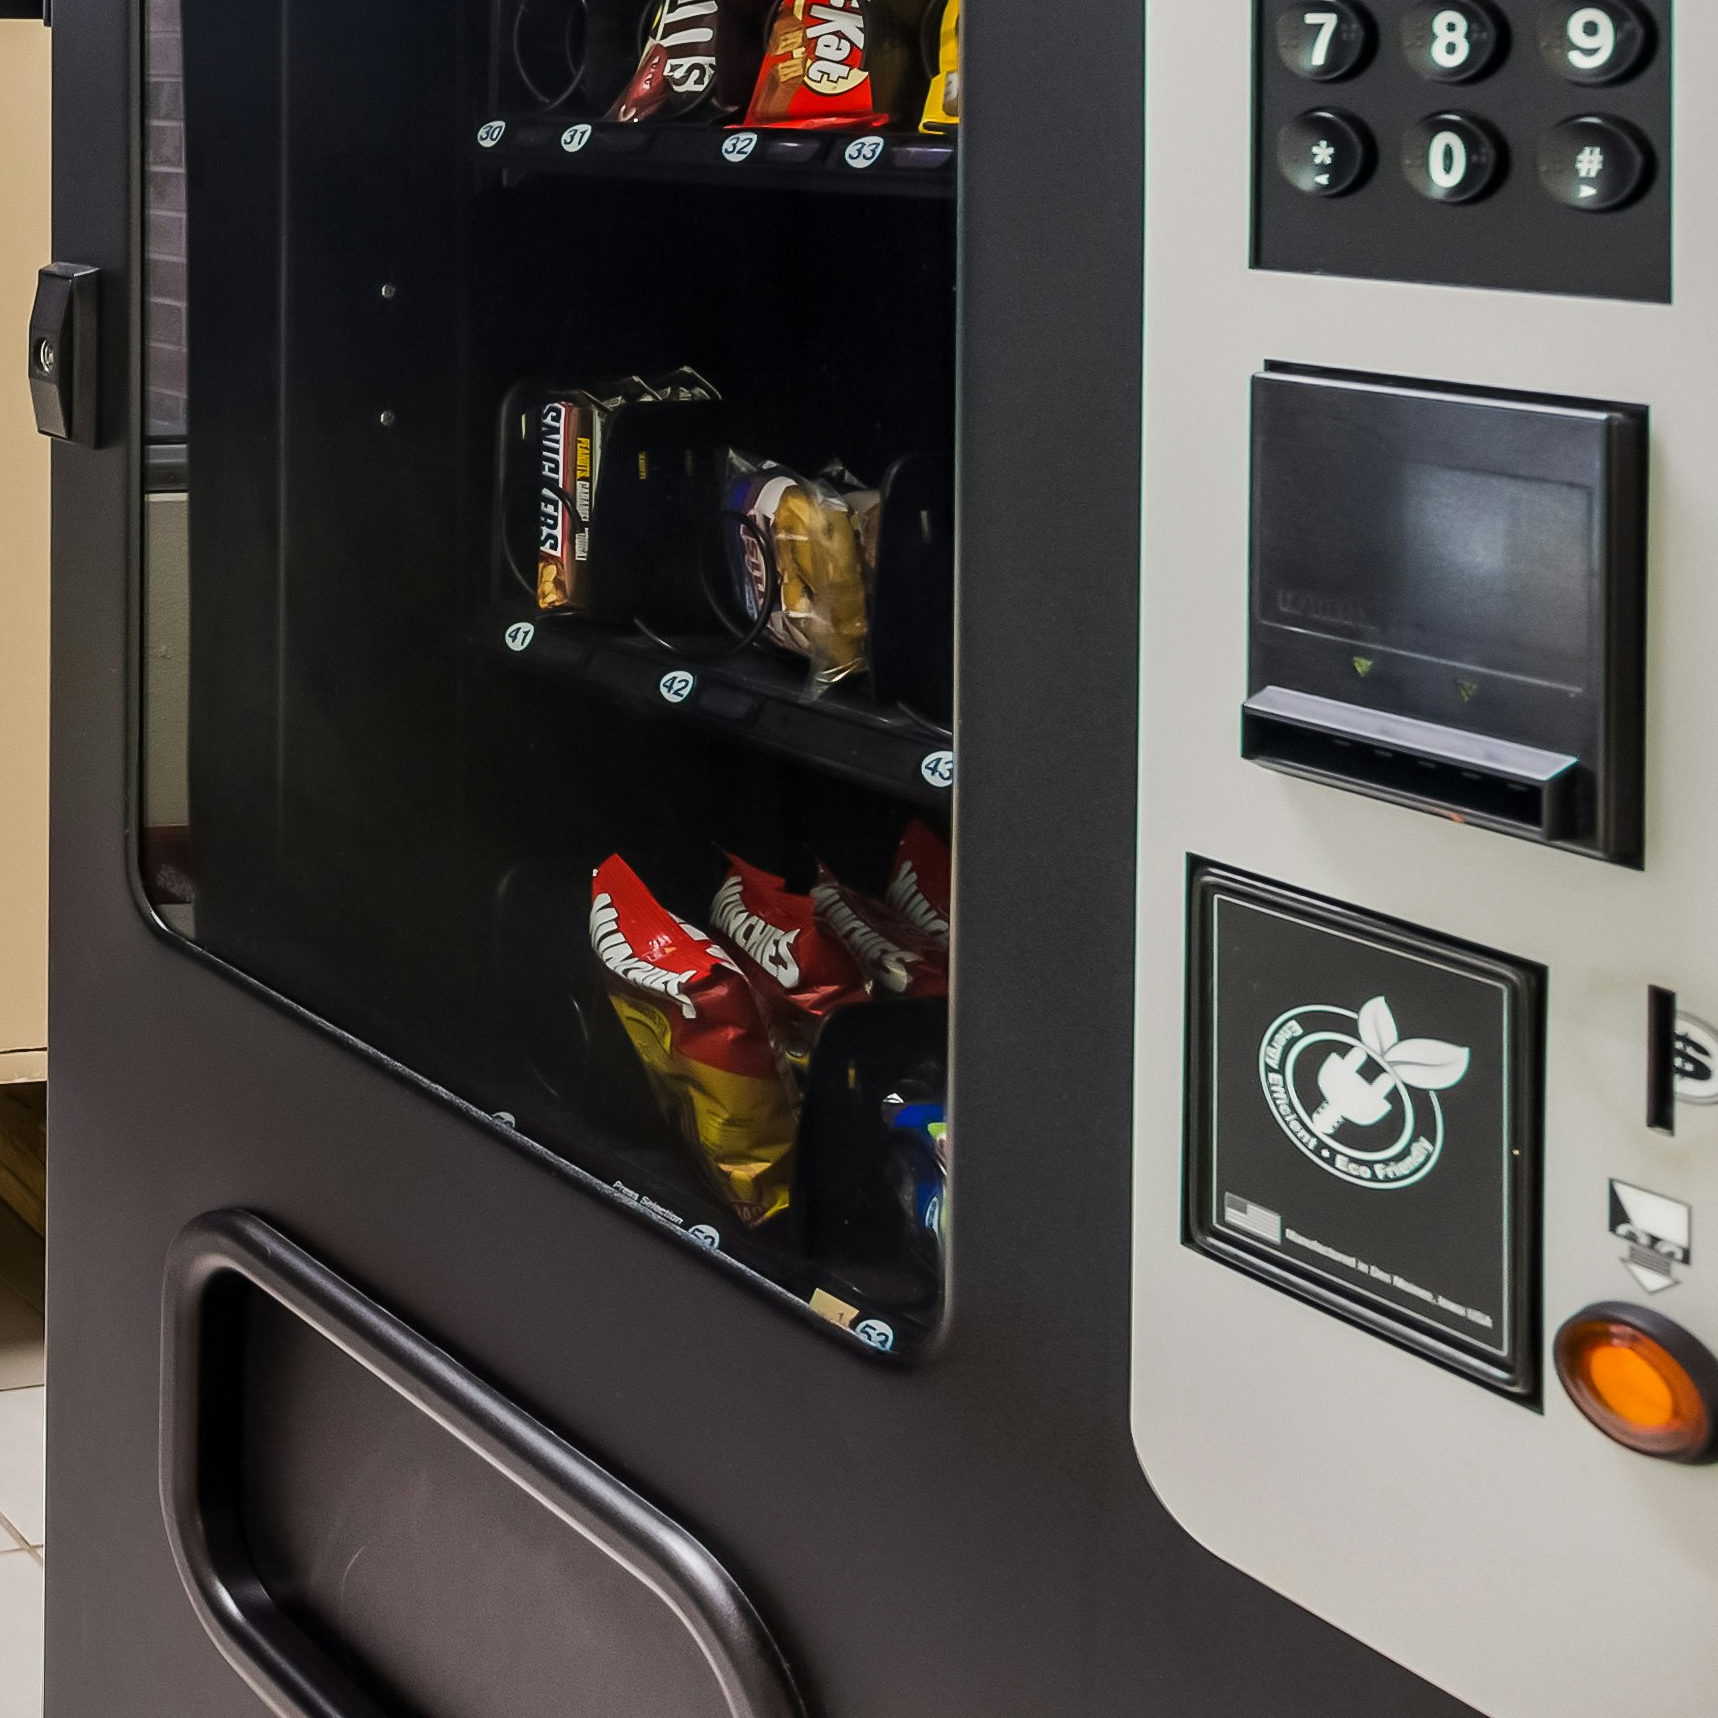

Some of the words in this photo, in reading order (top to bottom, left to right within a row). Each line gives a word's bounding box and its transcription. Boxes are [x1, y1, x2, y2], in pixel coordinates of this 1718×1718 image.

[1304, 12, 1337, 65] 7
[1430, 10, 1469, 67] 8
[1567, 8, 1615, 68] 9
[724, 136, 750, 155] 32
[848, 142, 879, 161] 33
[1428, 131, 1466, 188] 0
[508, 627, 531, 647] 41
[662, 677, 689, 698] 42
[1335, 1154, 1372, 1178] Eco
